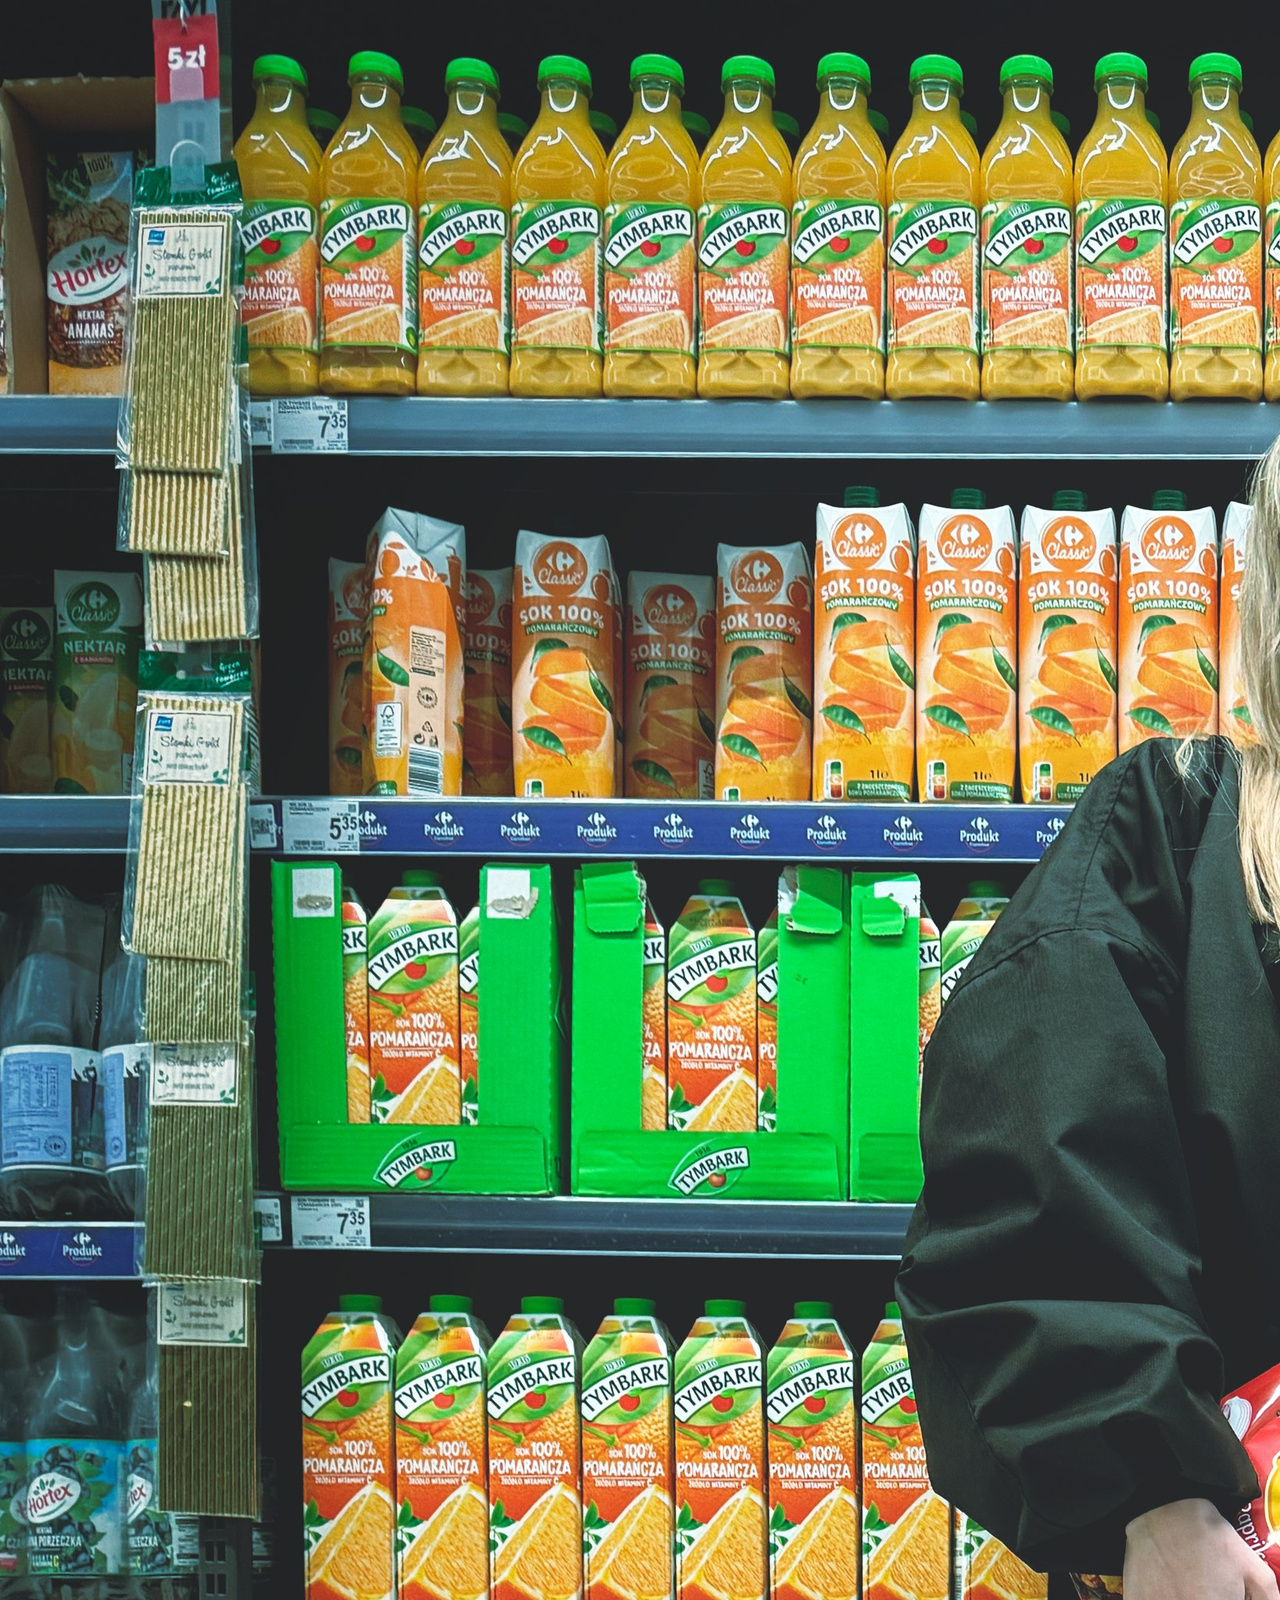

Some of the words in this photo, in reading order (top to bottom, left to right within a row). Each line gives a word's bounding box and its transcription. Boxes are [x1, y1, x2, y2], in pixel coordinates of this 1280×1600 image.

[167, 47, 183, 70] 5
[421, 213, 501, 258] TYMBARK
[797, 210, 877, 255] TYMBARK
[1179, 207, 1257, 255] TYMBARK
[834, 268, 863, 284] 100%
[1217, 267, 1246, 283] 100%
[798, 284, 867, 301] POMARAŃCZA
[1181, 281, 1251, 300] POMARAŃCZA
[65, 323, 115, 340] ANANAS
[837, 538, 883, 560] Classic
[537, 567, 585, 586] Classic
[820, 579, 849, 600] SOK
[856, 577, 904, 602] 100%
[826, 595, 900, 612] POMARAŃCZOWY
[519, 606, 553, 626] SOK
[557, 604, 605, 629] 100%
[63, 639, 127, 655] NEKTAR
[424, 824, 464, 840] Produkt
[807, 826, 847, 842] Produkt
[368, 929, 456, 983] TYMBARK
[669, 945, 756, 992] TYMBARK
[412, 1012, 445, 1029] 100%
[370, 1030, 454, 1049] POMARAŃCZA
[384, 1142, 452, 1182] TYMBARK
[678, 1150, 745, 1190] TYMBARK
[395, 1360, 479, 1411] TYMBARK
[583, 1364, 667, 1415] TYMBARK
[438, 1441, 470, 1456] 100%
[397, 1456, 479, 1475] POMARAŃCZA
